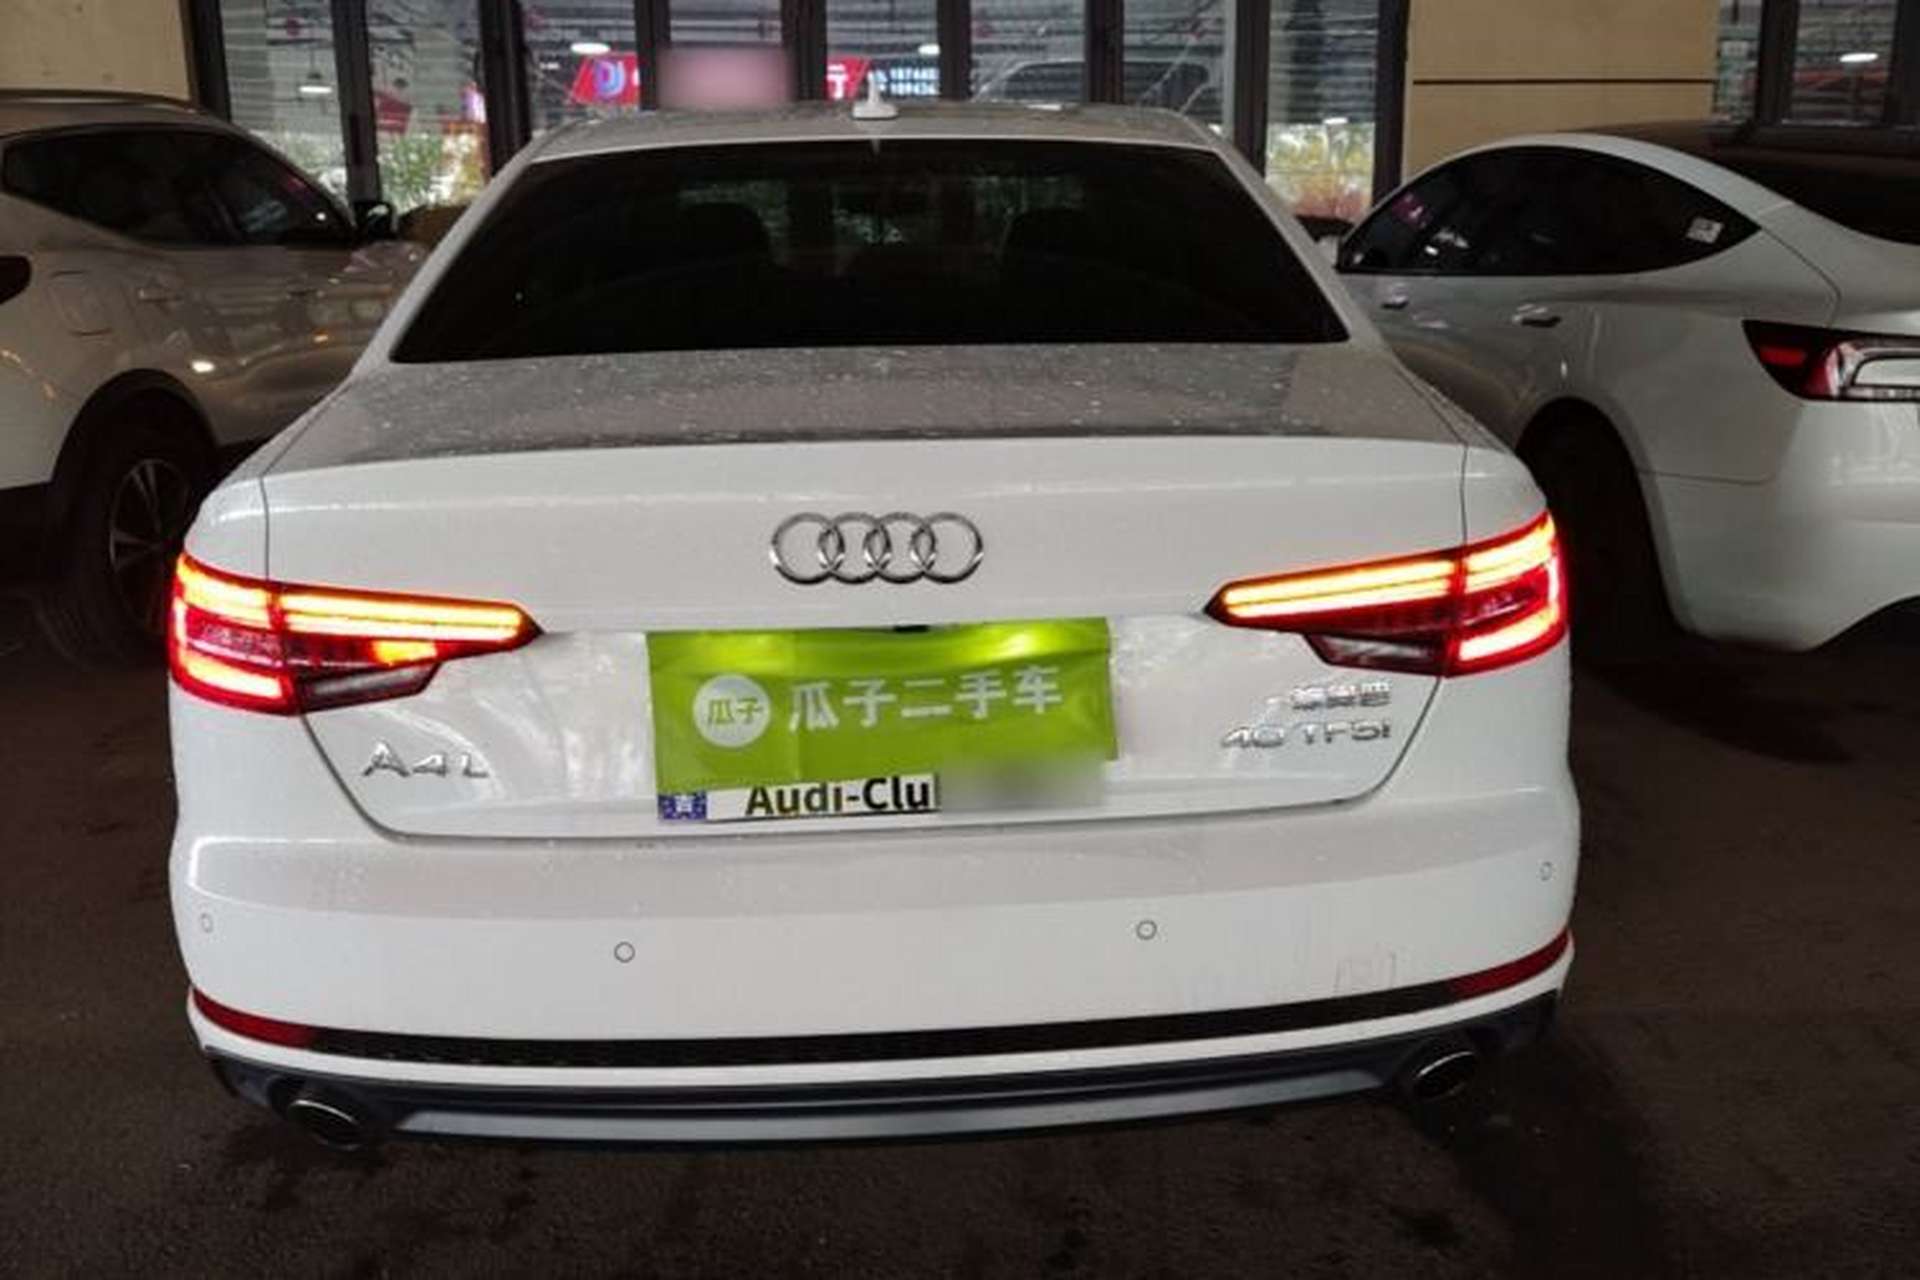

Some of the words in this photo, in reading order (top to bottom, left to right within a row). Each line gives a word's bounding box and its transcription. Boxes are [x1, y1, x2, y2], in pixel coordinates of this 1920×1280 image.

[707, 697, 760, 725] 瓜子
[789, 667, 1063, 732] 瓜子二手车
